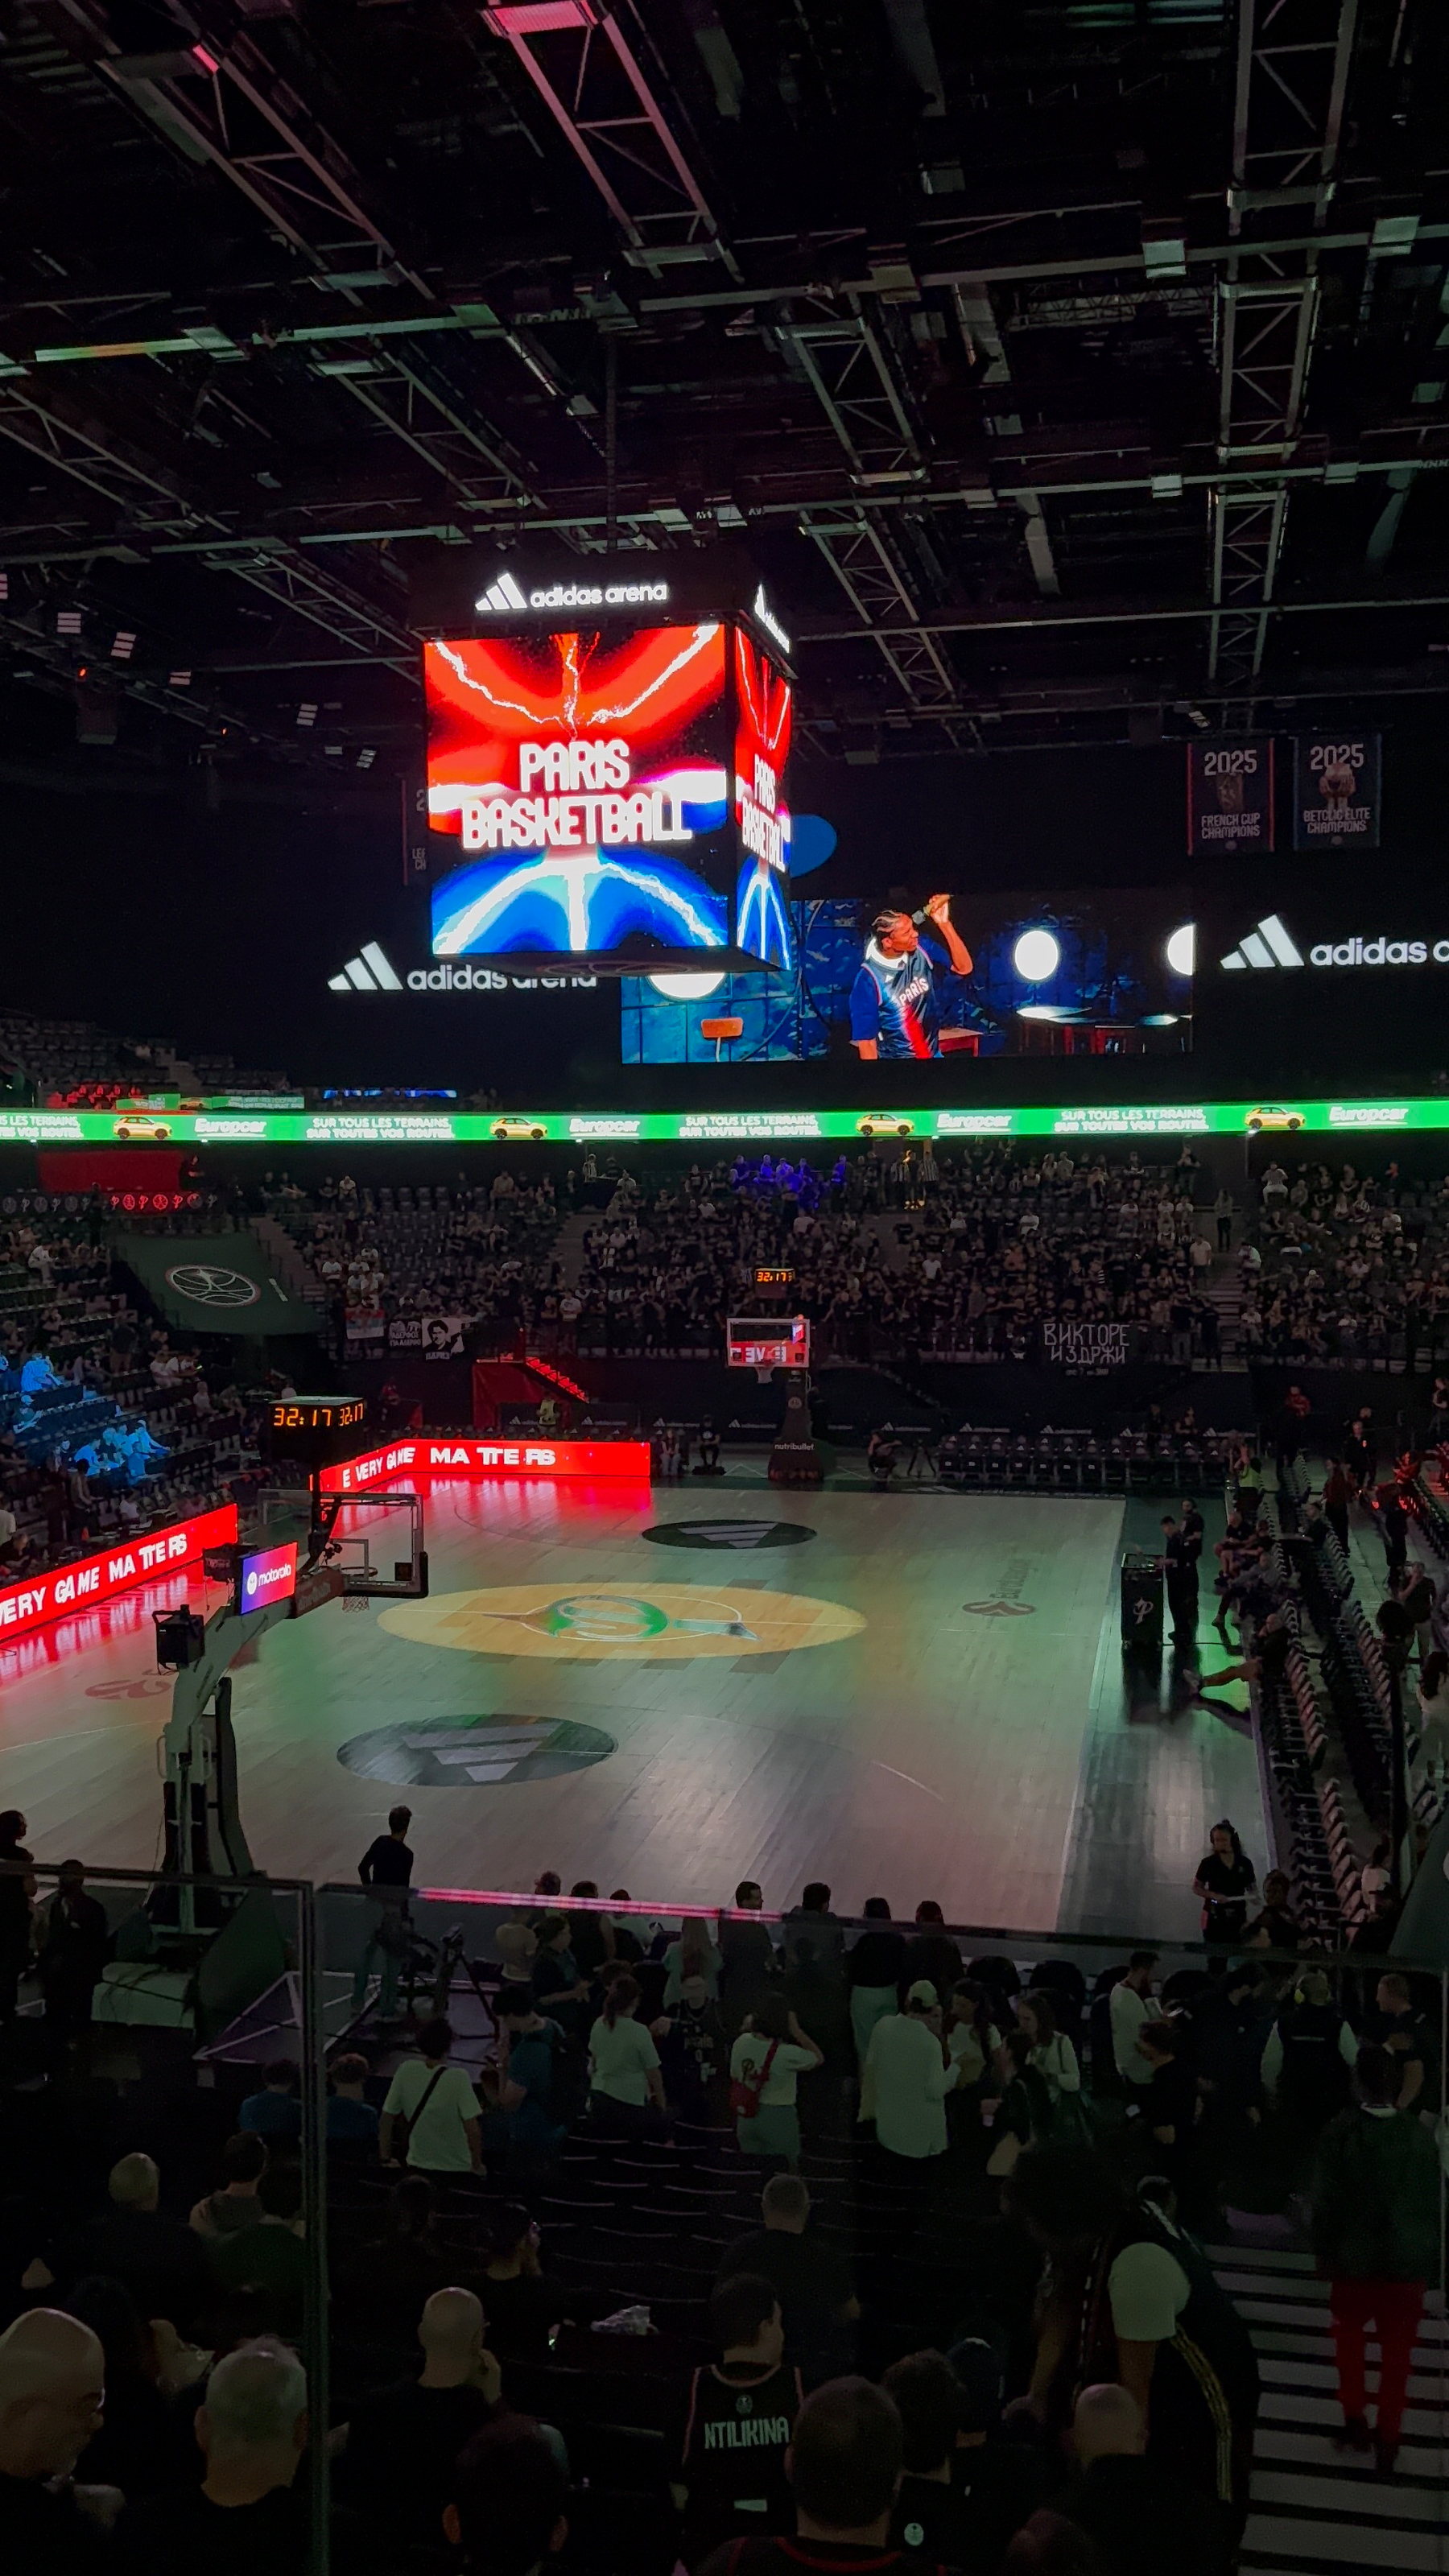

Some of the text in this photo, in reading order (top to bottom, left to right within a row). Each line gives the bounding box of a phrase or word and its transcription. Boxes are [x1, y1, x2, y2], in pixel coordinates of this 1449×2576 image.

[530, 584, 667, 608] adidas arena
[520, 739, 630, 792] PARIS
[1203, 749, 1258, 777] 2025
[1309, 742, 1364, 771] 2025
[754, 753, 775, 813] PARIS
[462, 791, 691, 848] BASKETBALL
[1201, 812, 1261, 828] FRENCH CUP
[1303, 807, 1373, 823] BETCLIC ELITE
[742, 796, 786, 873] BASKETBALL
[1201, 824, 1261, 840] CHAMPIONS
[1307, 819, 1368, 834] CHAMPIONS
[1310, 937, 1427, 966] adidas
[407, 965, 508, 991] adidas
[899, 976, 929, 1006] PARIS
[312, 1117, 336, 1128] SUR
[338, 1118, 369, 1128] TOUS
[372, 1118, 392, 1128] LES
[686, 1117, 708, 1126] SUR
[709, 1117, 739, 1126] TOUS
[741, 1116, 761, 1125] LES
[937, 1113, 1013, 1129] Europcar
[1061, 1110, 1086, 1121] SUR
[1087, 1110, 1120, 1120] TOUS
[1121, 1109, 1143, 1120] LES
[1329, 1106, 1409, 1123] Europcar
[195, 1118, 266, 1133] Europcar
[306, 1129, 331, 1138] SUR
[569, 1118, 641, 1133] Europcar
[679, 1127, 703, 1137] SUR
[1055, 1121, 1080, 1132] SUR
[1043, 1323, 1130, 1347] ВИКТОРЕ
[1051, 1345, 1126, 1364] ИЗДРЖИ
[274, 1407, 332, 1426] 32:17
[339, 1402, 364, 1426] 32:17
[774, 1443, 815, 1451] nutribullet
[258, 1563, 292, 1587] motorola
[704, 2415, 790, 2450] NTILIKINA
